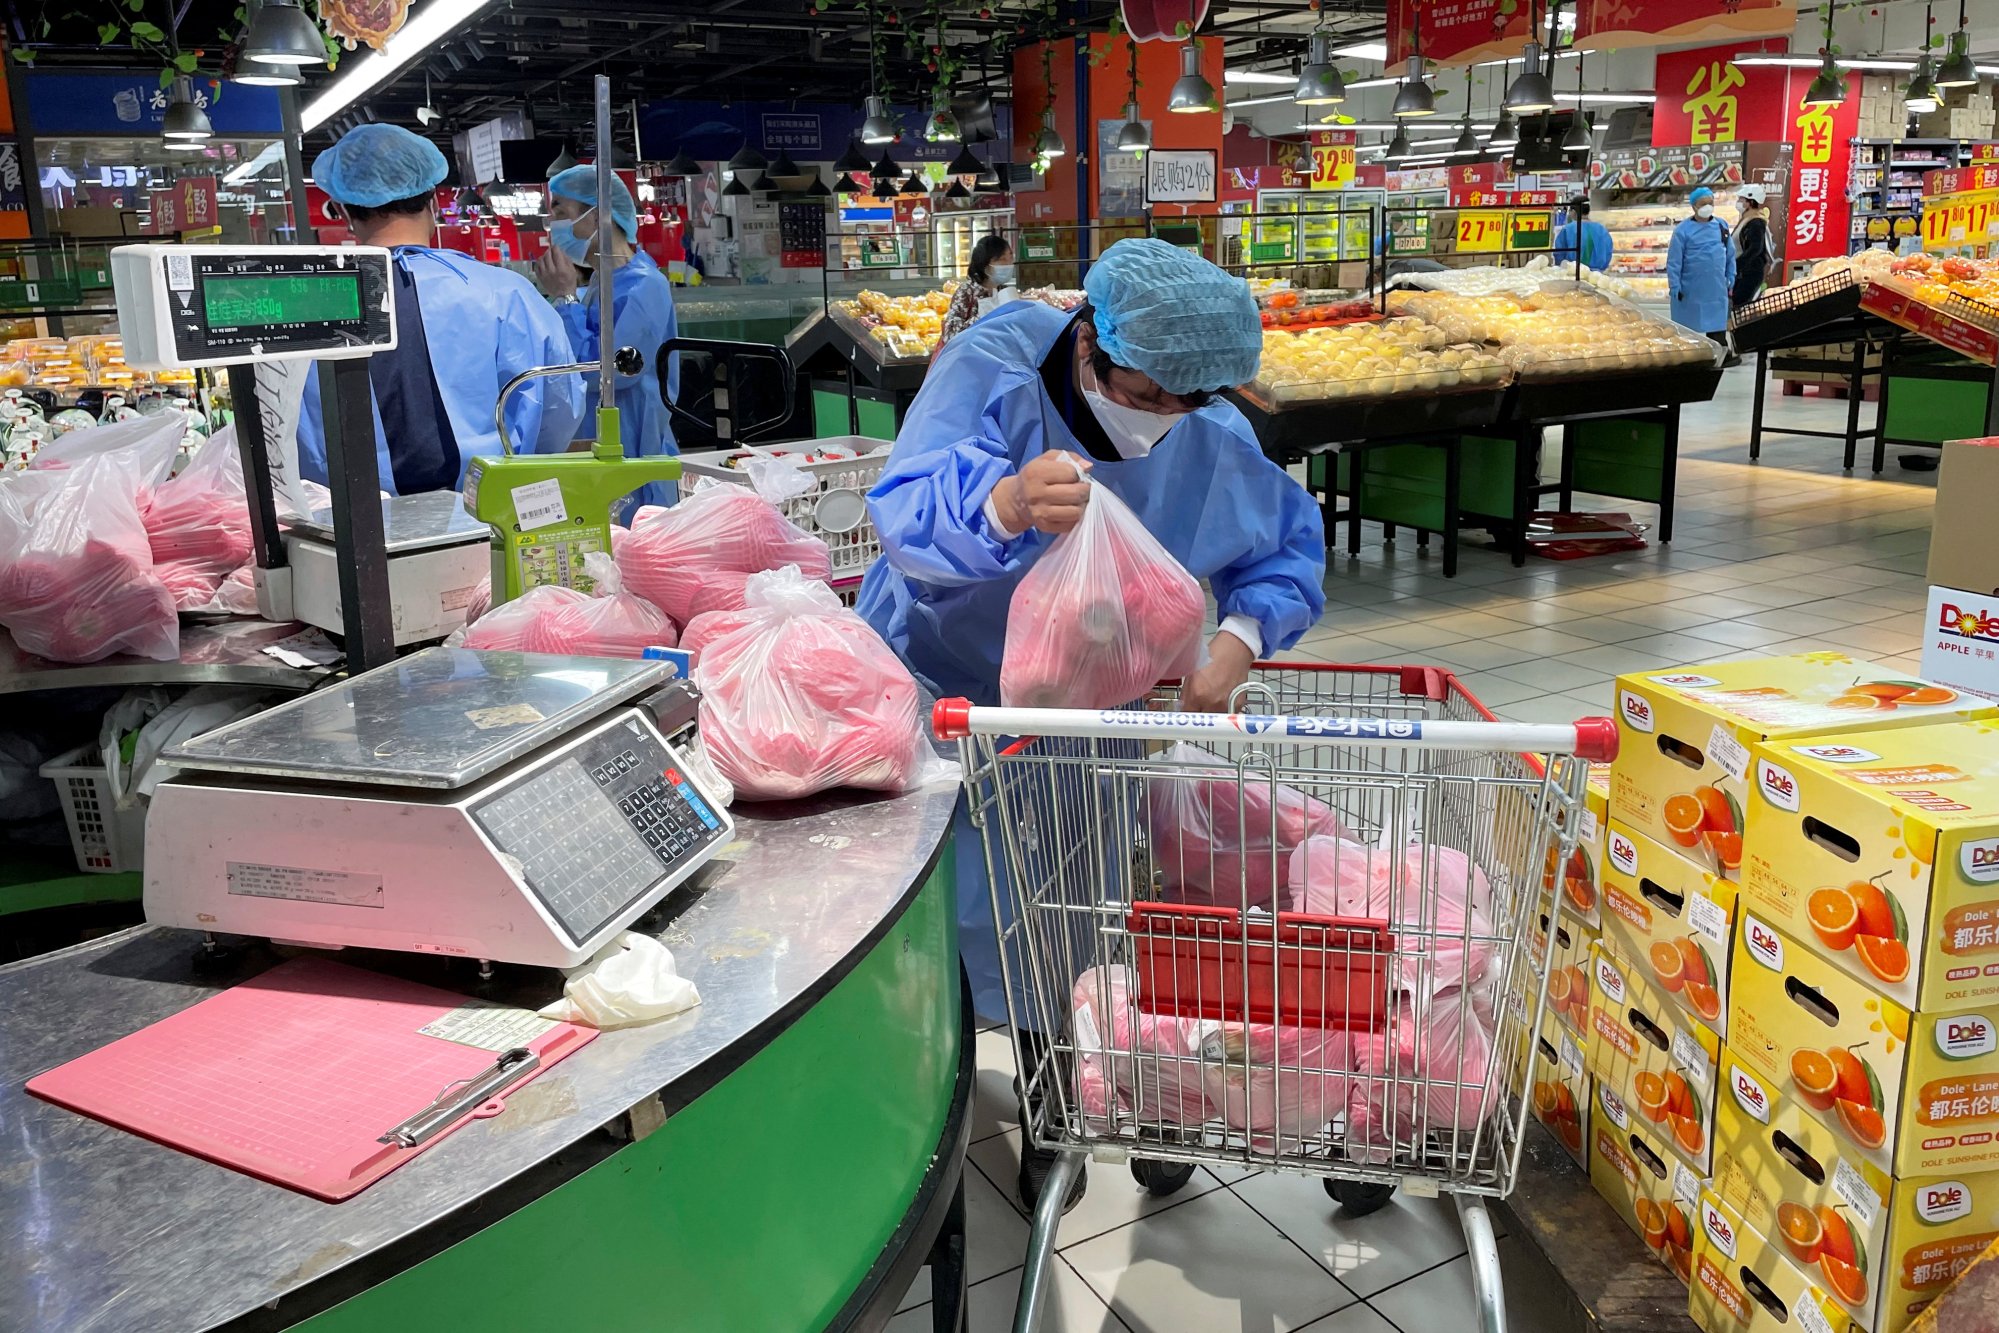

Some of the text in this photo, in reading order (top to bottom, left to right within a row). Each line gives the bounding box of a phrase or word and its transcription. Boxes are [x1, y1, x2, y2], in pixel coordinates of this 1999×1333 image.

[1151, 160, 1211, 194] 限购2份
[1313, 150, 1339, 183] 32
[1341, 149, 1355, 164] 90
[1816, 169, 1830, 243] Saving More
[1928, 206, 1965, 241] 17 80
[1968, 204, 1988, 233] 17
[1460, 220, 1502, 242] 27 80
[1940, 603, 1999, 637] Dole
[1937, 641, 1995, 660] APPLE 苹果
[1627, 697, 1649, 717] Dole
[1766, 768, 1793, 793] Dole
[1614, 838, 1634, 860] Dole
[1965, 912, 1990, 923] Dole
[1752, 926, 1778, 953] Dole
[1602, 965, 1621, 988] Dole
[1945, 990, 1968, 1000] DOLE
[1948, 1022, 1986, 1041] Dole
[1739, 1076, 1764, 1105] Dole
[1941, 1082, 1998, 1096] Dole Lane
[1921, 1159, 1943, 1168] DOLE
[1947, 1155, 1987, 1164] SUNSHINE
[1927, 1187, 1962, 1206] Dole
[1709, 1211, 1732, 1241] Dole
[1922, 1250, 1944, 1260] Dole
[1951, 1242, 1974, 1254] Lane
